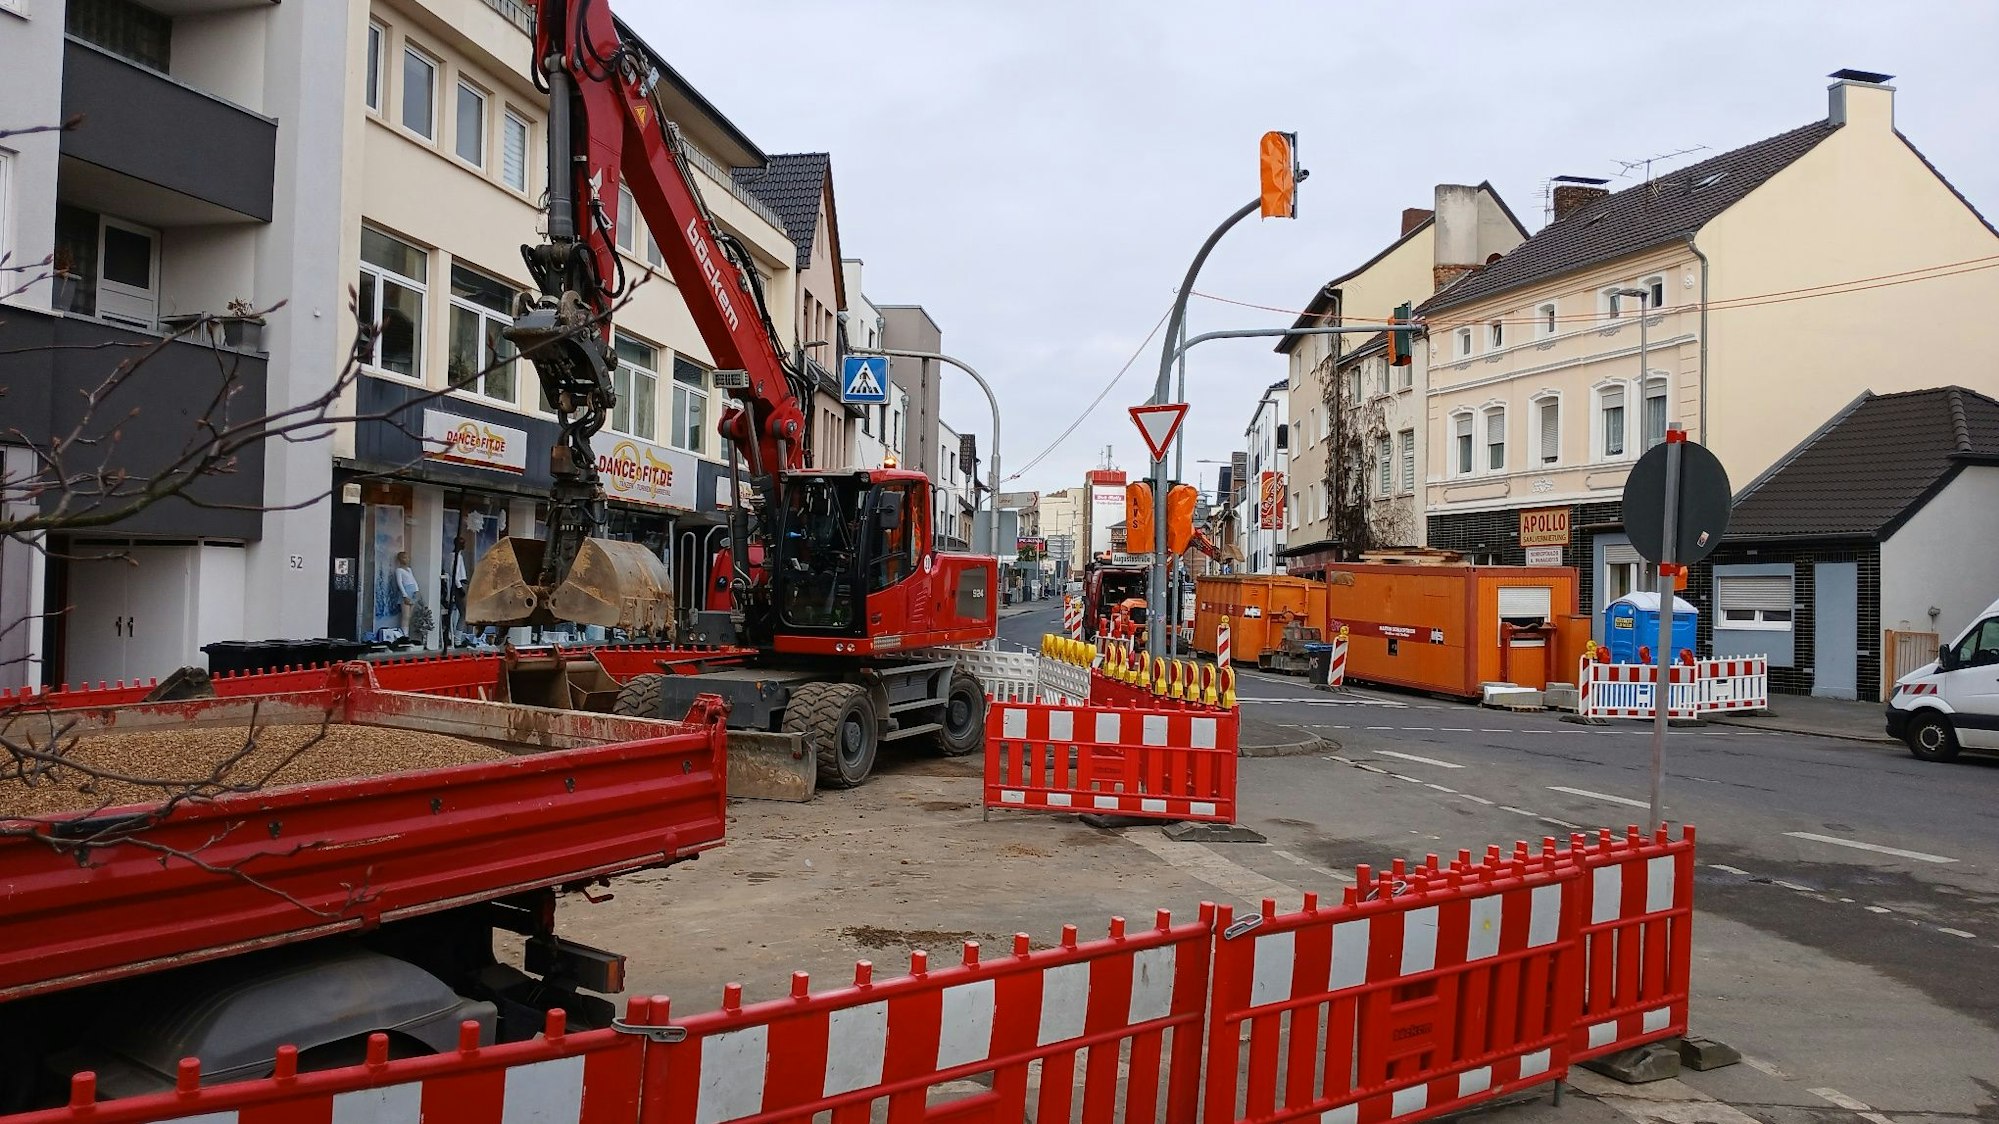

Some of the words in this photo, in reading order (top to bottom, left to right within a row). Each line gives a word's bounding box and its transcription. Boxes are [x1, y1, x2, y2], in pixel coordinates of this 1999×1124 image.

[686, 217, 739, 332] böckem
[1523, 513, 1566, 533] APOLLO
[290, 556, 303, 569] 52
[972, 589, 984, 598] 924
